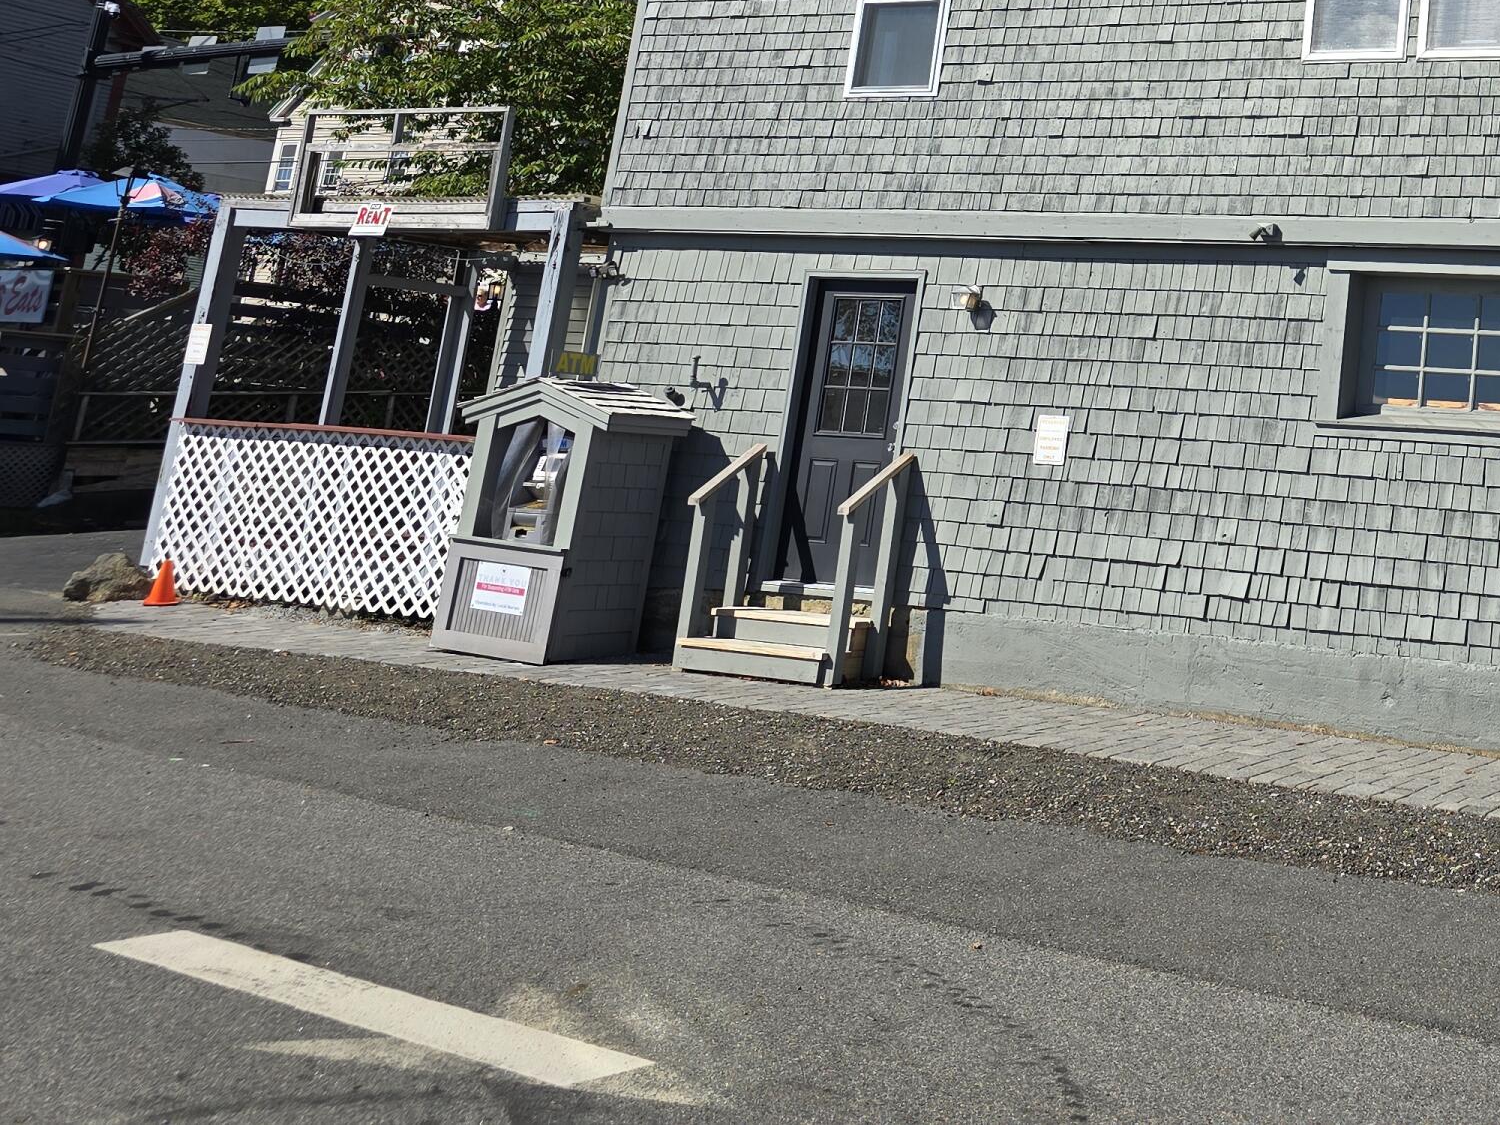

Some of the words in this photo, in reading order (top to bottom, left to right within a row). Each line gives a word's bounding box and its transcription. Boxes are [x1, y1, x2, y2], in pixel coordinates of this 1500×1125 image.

[356, 207, 391, 225] RENT
[4, 275, 42, 315] Eats
[556, 352, 597, 374] ATM
[479, 574, 507, 583] THANK
[511, 578, 527, 588] YOU
